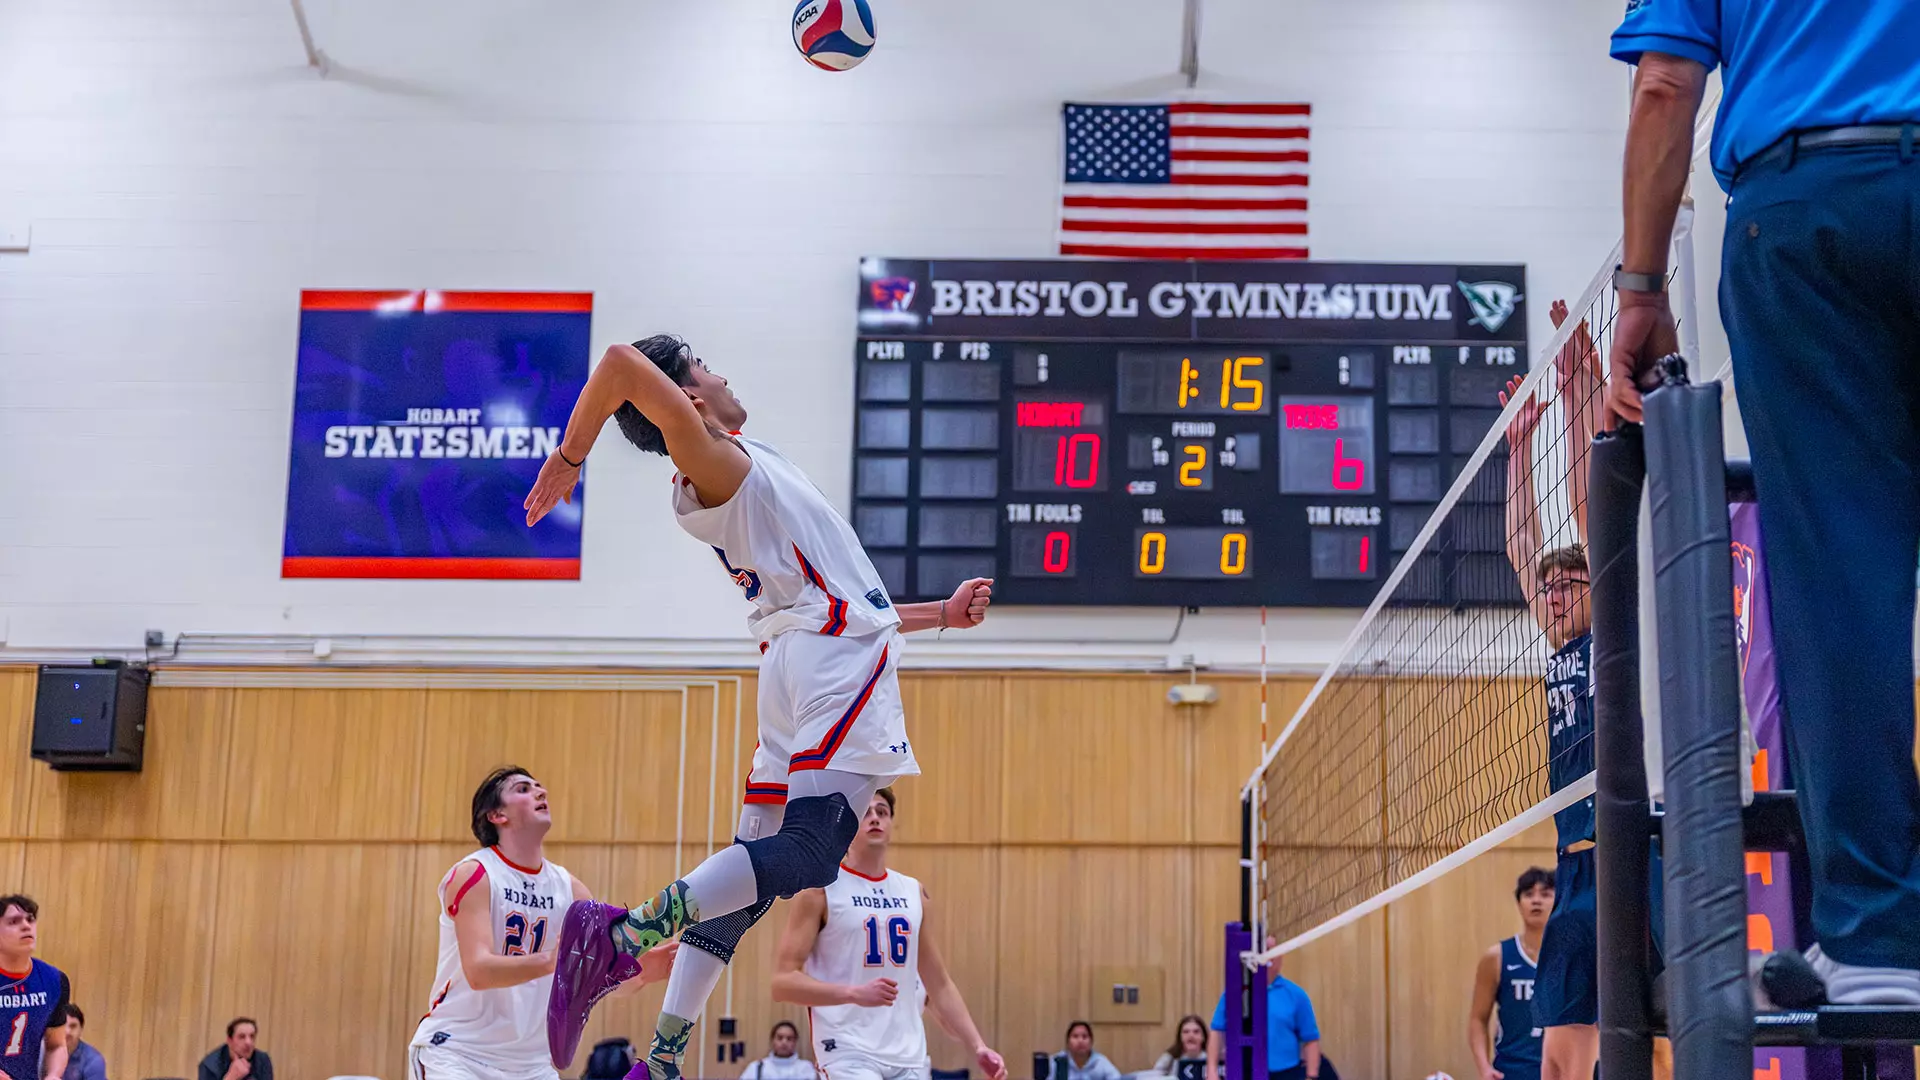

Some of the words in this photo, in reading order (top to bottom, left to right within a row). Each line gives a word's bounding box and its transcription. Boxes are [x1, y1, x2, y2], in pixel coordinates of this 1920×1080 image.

[796, 6, 819, 29] NCAA
[931, 280, 1138, 317] BRISTOL
[1148, 281, 1452, 319] GYMNASIUM
[933, 342, 944, 360] F
[960, 342, 990, 360] PTS
[1458, 346, 1470, 365] F
[1485, 347, 1516, 365] PTS
[1178, 356, 1264, 411] 1:15
[406, 408, 482, 425] HOBART
[1017, 402, 1084, 428] HOBART
[1172, 421, 1216, 437] PERIOD
[325, 426, 560, 459] STATESMEN
[1054, 433, 1100, 488] 10
[1179, 445, 1206, 487] 2
[1332, 437, 1365, 490] 6
[1006, 504, 1031, 523] TM
[1034, 504, 1082, 523] FOULS
[1306, 506, 1331, 525] TM
[1334, 506, 1381, 526] FOULS
[1043, 531, 1070, 573] 0
[1139, 532, 1167, 574] 0
[1220, 533, 1247, 575] 0
[1359, 535, 1370, 573] 1
[504, 887, 554, 910] HOBART
[852, 896, 910, 909] HOBART
[502, 911, 548, 956] 21
[863, 914, 911, 968] 16
[4, 1011, 29, 1057] 1
